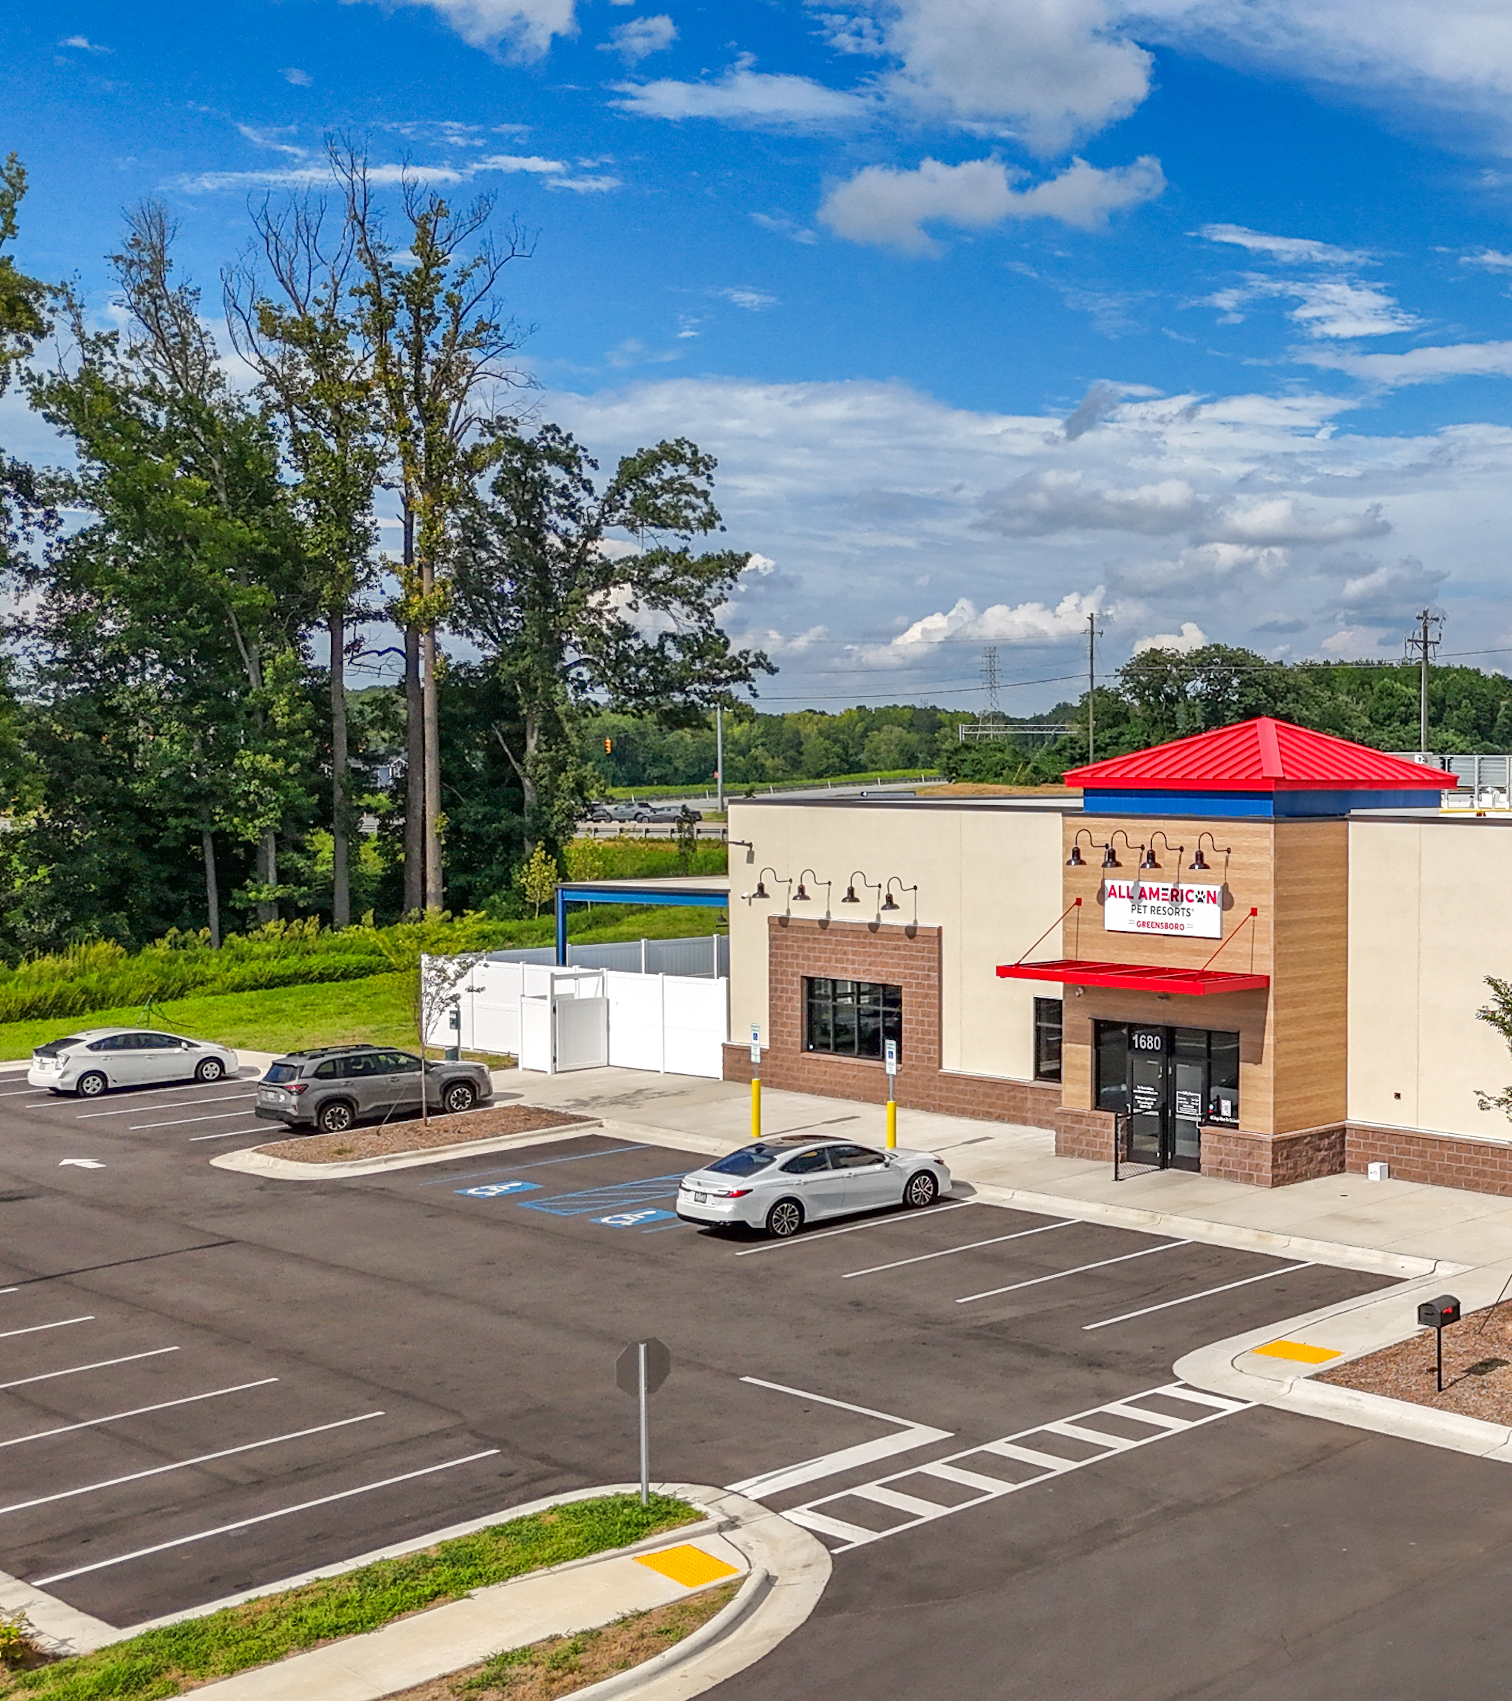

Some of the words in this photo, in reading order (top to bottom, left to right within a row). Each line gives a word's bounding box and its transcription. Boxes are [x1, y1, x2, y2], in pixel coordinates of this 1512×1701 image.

[1107, 884, 1134, 900] ALL
[1131, 904, 1148, 914] PET
[1150, 905, 1192, 917] RESORTS
[1136, 920, 1185, 931] GREENSBORO
[1132, 1033, 1162, 1051] 1680
